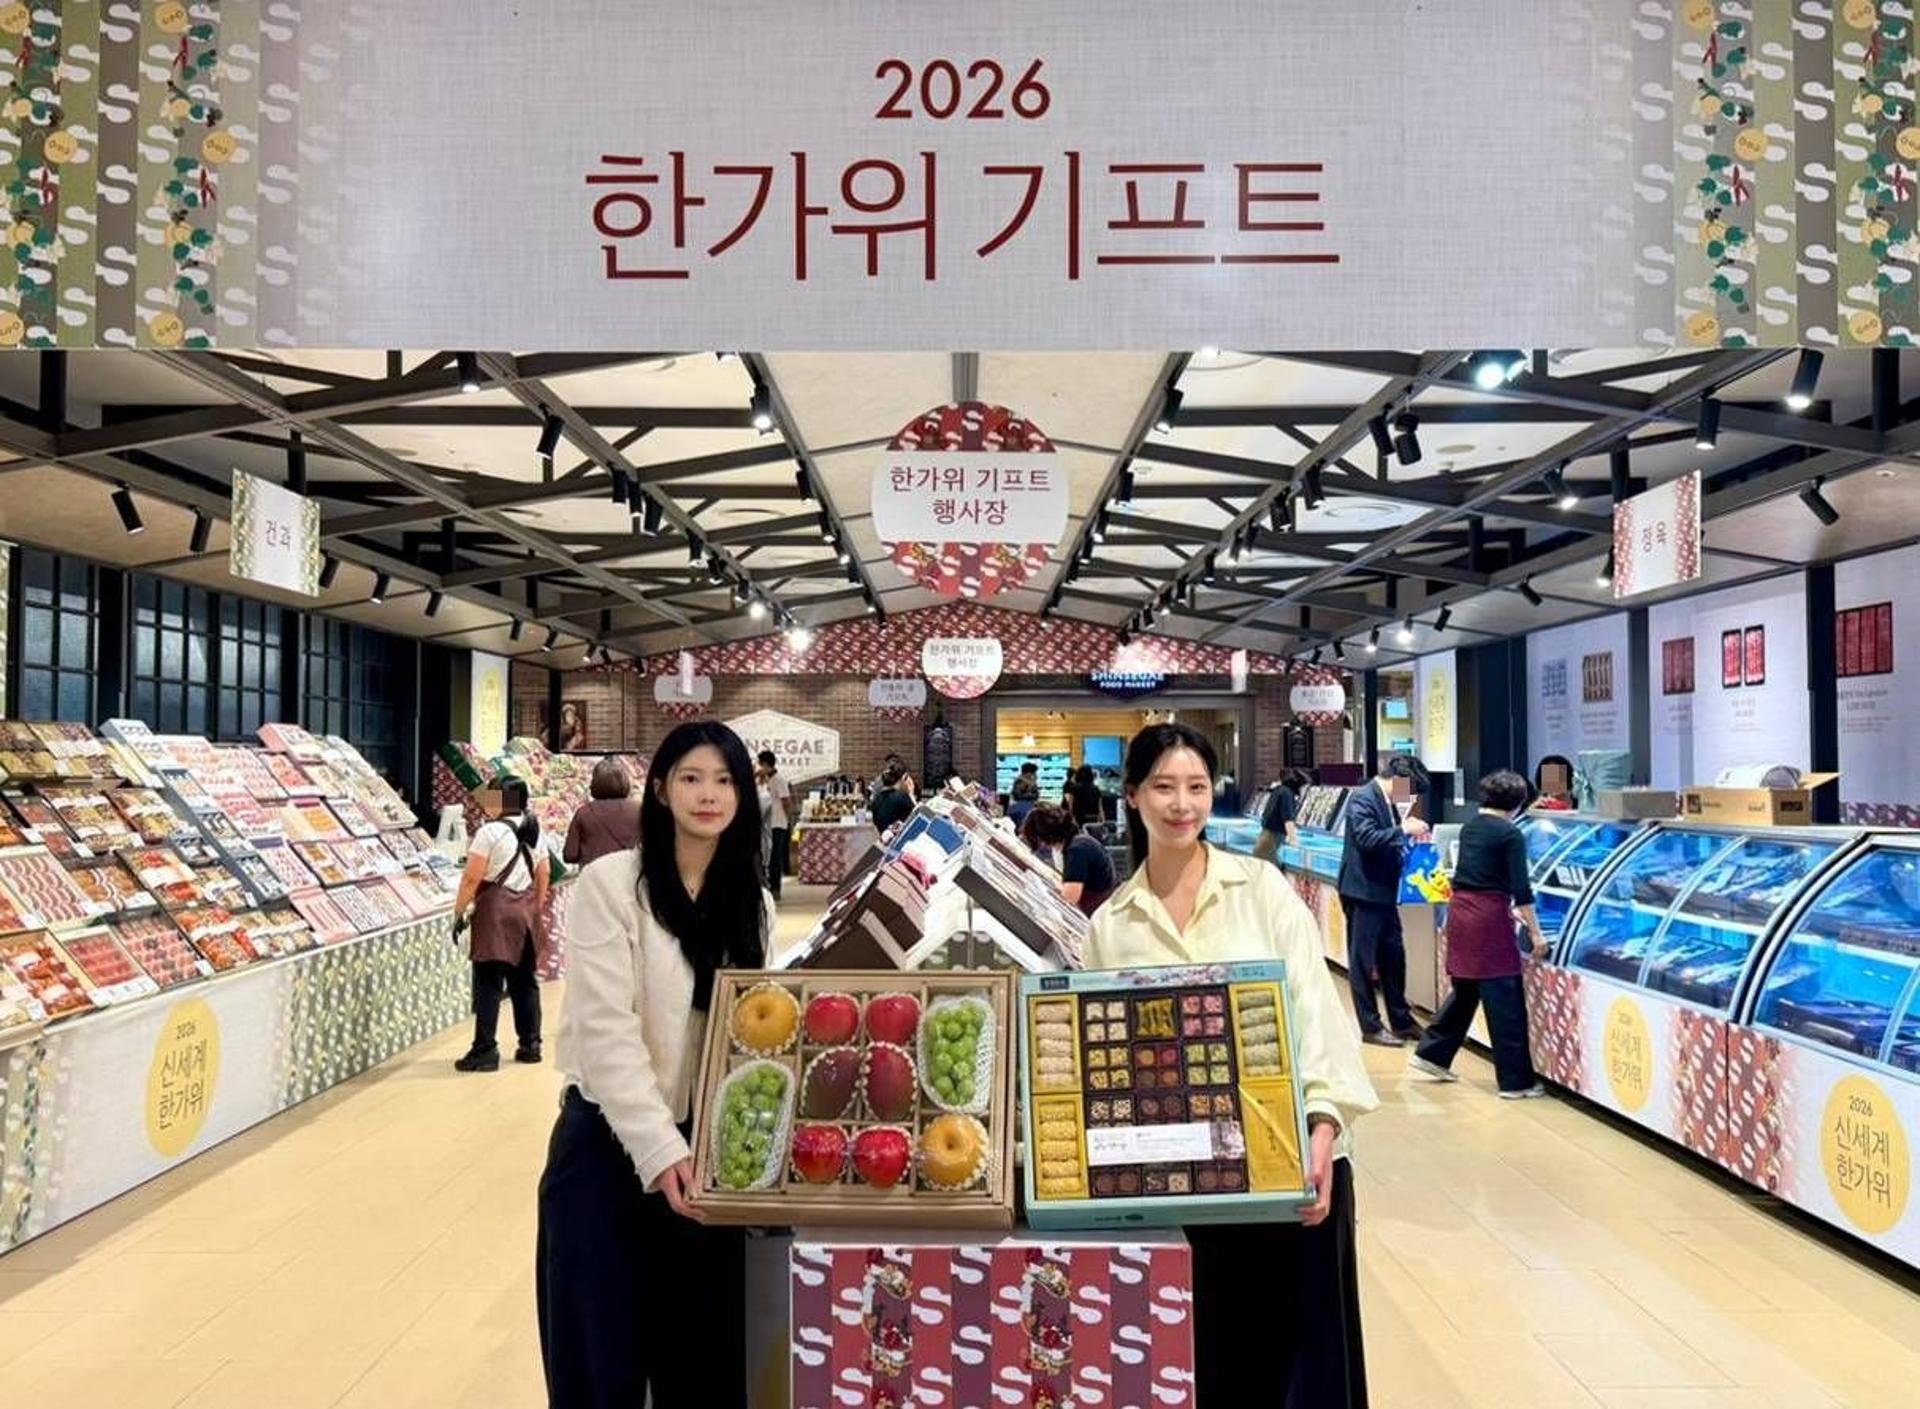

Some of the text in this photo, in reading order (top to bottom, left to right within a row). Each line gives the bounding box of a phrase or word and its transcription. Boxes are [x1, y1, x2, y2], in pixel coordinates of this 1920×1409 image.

[875, 59, 1052, 120] 2026
[585, 151, 1341, 281] 한가위 기프트
[890, 465, 1052, 493] 한가위 기프트
[266, 519, 292, 552] 건과
[932, 498, 1009, 526] 행사장
[745, 739, 825, 755] NSEGAE
[161, 1038, 207, 1088] 신세계
[159, 1078, 204, 1130] 한가위
[1849, 1095, 1873, 1117] 2026
[1835, 1115, 1890, 1168] 신세계
[1836, 1153, 1891, 1209] 한가위
